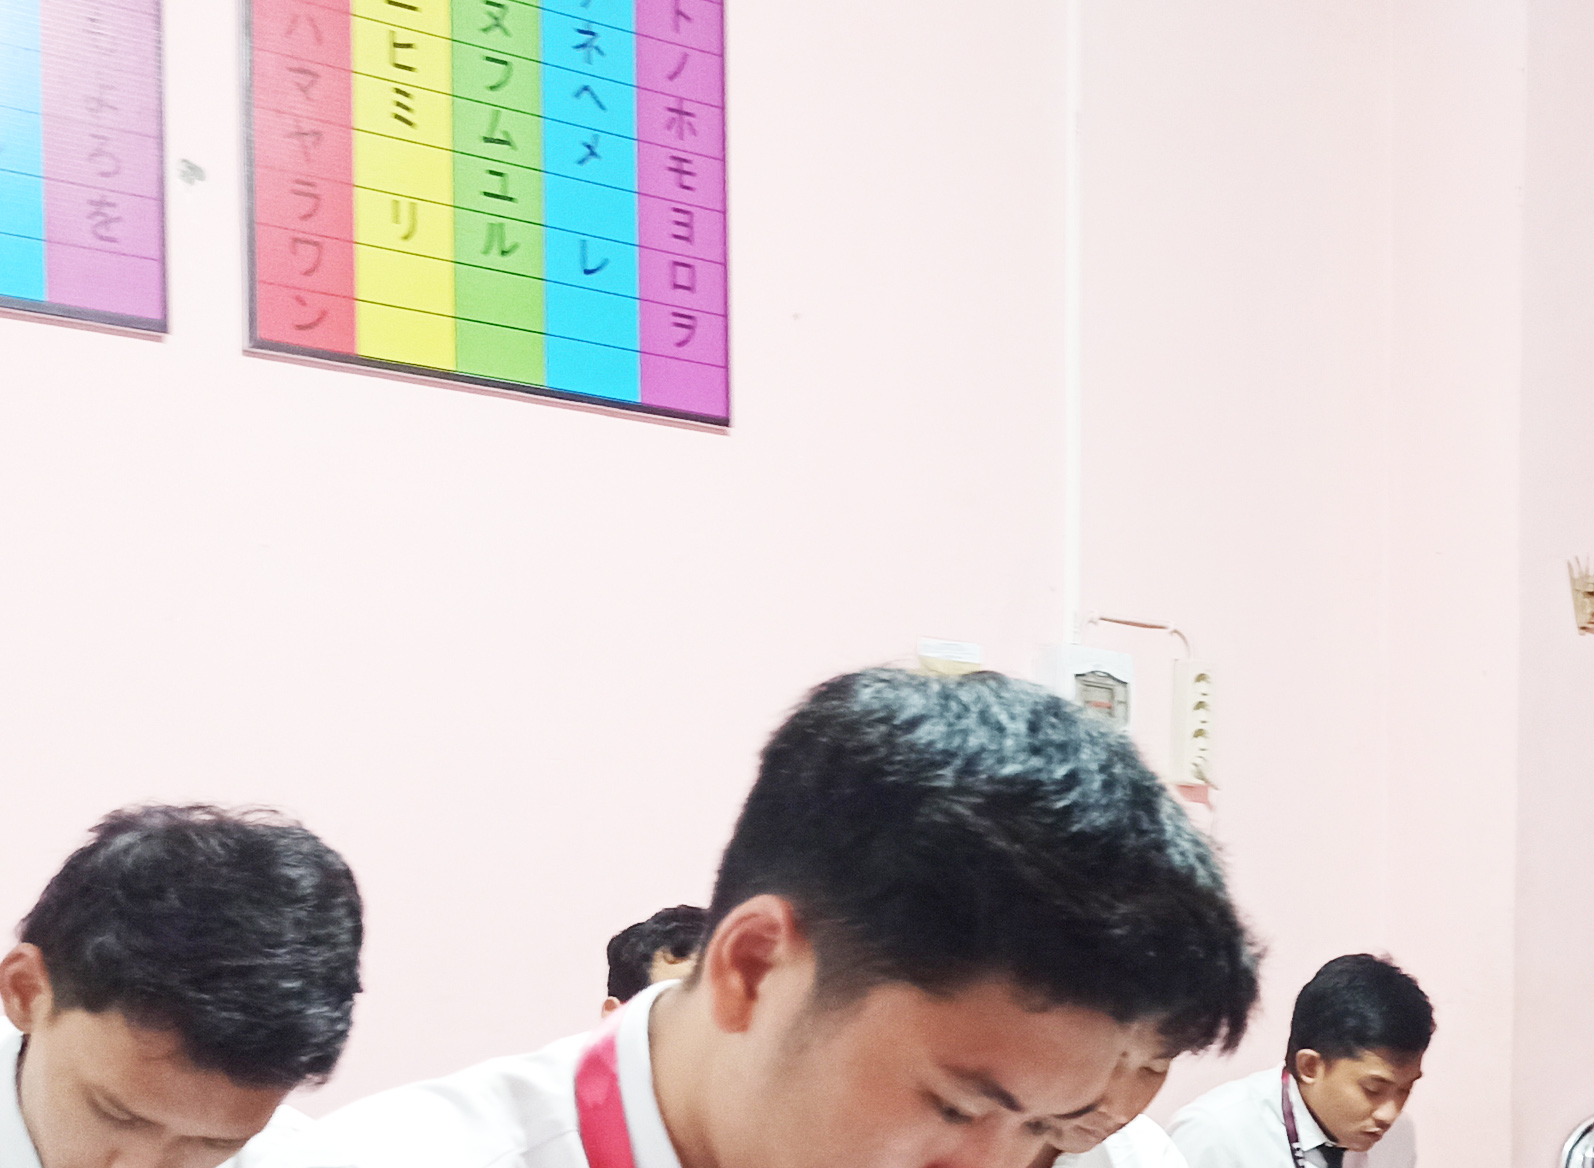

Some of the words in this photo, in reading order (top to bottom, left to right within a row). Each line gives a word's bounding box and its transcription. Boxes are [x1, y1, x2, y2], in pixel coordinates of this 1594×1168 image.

[285, 13, 323, 44] ハ
[387, 29, 418, 72] ヒ
[483, 55, 514, 91] フ
[664, 99, 698, 141] ホ
[479, 0, 513, 37] ヌ
[572, 22, 607, 65] ネ
[667, 51, 691, 82] ノ
[286, 66, 320, 99] マ
[391, 86, 416, 129] ミ
[480, 109, 518, 151] ム
[575, 133, 602, 166] メ
[665, 154, 698, 192] モ
[86, 194, 122, 243] を
[285, 119, 323, 163] ヤ
[480, 168, 518, 203] ユ
[671, 206, 695, 244] ヨ
[289, 236, 324, 277] ワ
[291, 178, 323, 221] ラ
[391, 199, 419, 241] リ
[480, 221, 520, 256] ル
[580, 239, 611, 275] レ
[669, 260, 697, 293] ロ
[293, 295, 328, 331] ン
